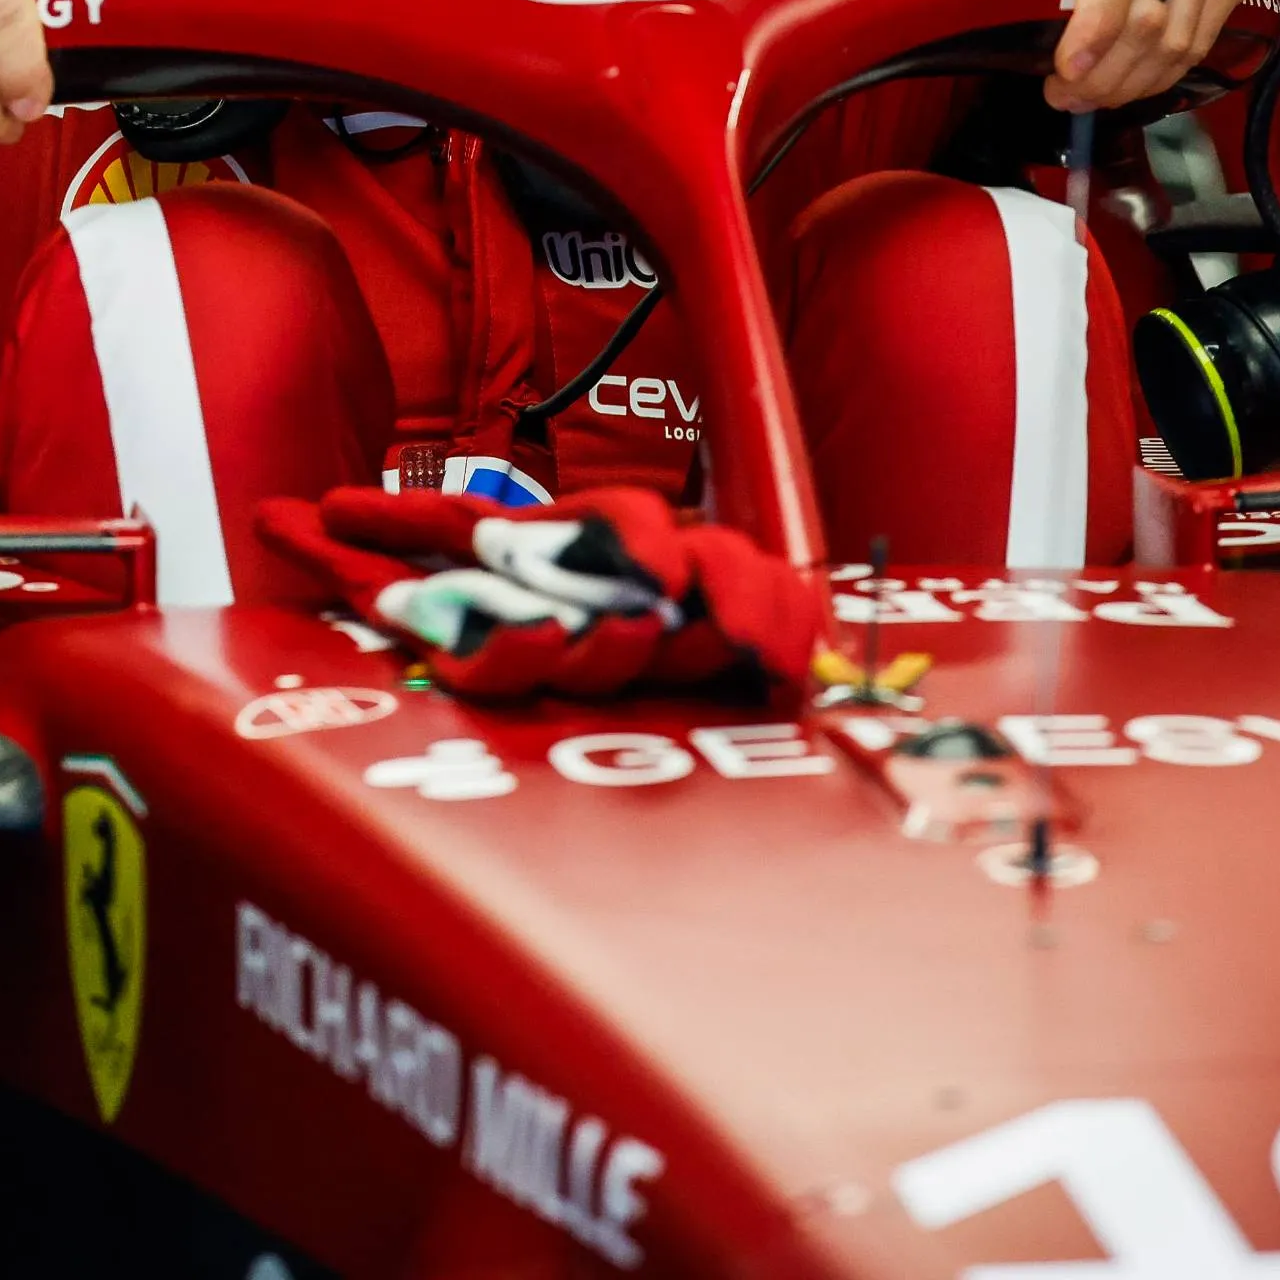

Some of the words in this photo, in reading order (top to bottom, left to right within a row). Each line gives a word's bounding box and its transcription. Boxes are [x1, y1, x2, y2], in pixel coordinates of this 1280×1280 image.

[665, 426, 700, 441] LOGI
[235, 898, 462, 1149] RICHARD
[460, 1053, 666, 1270] MILLE
